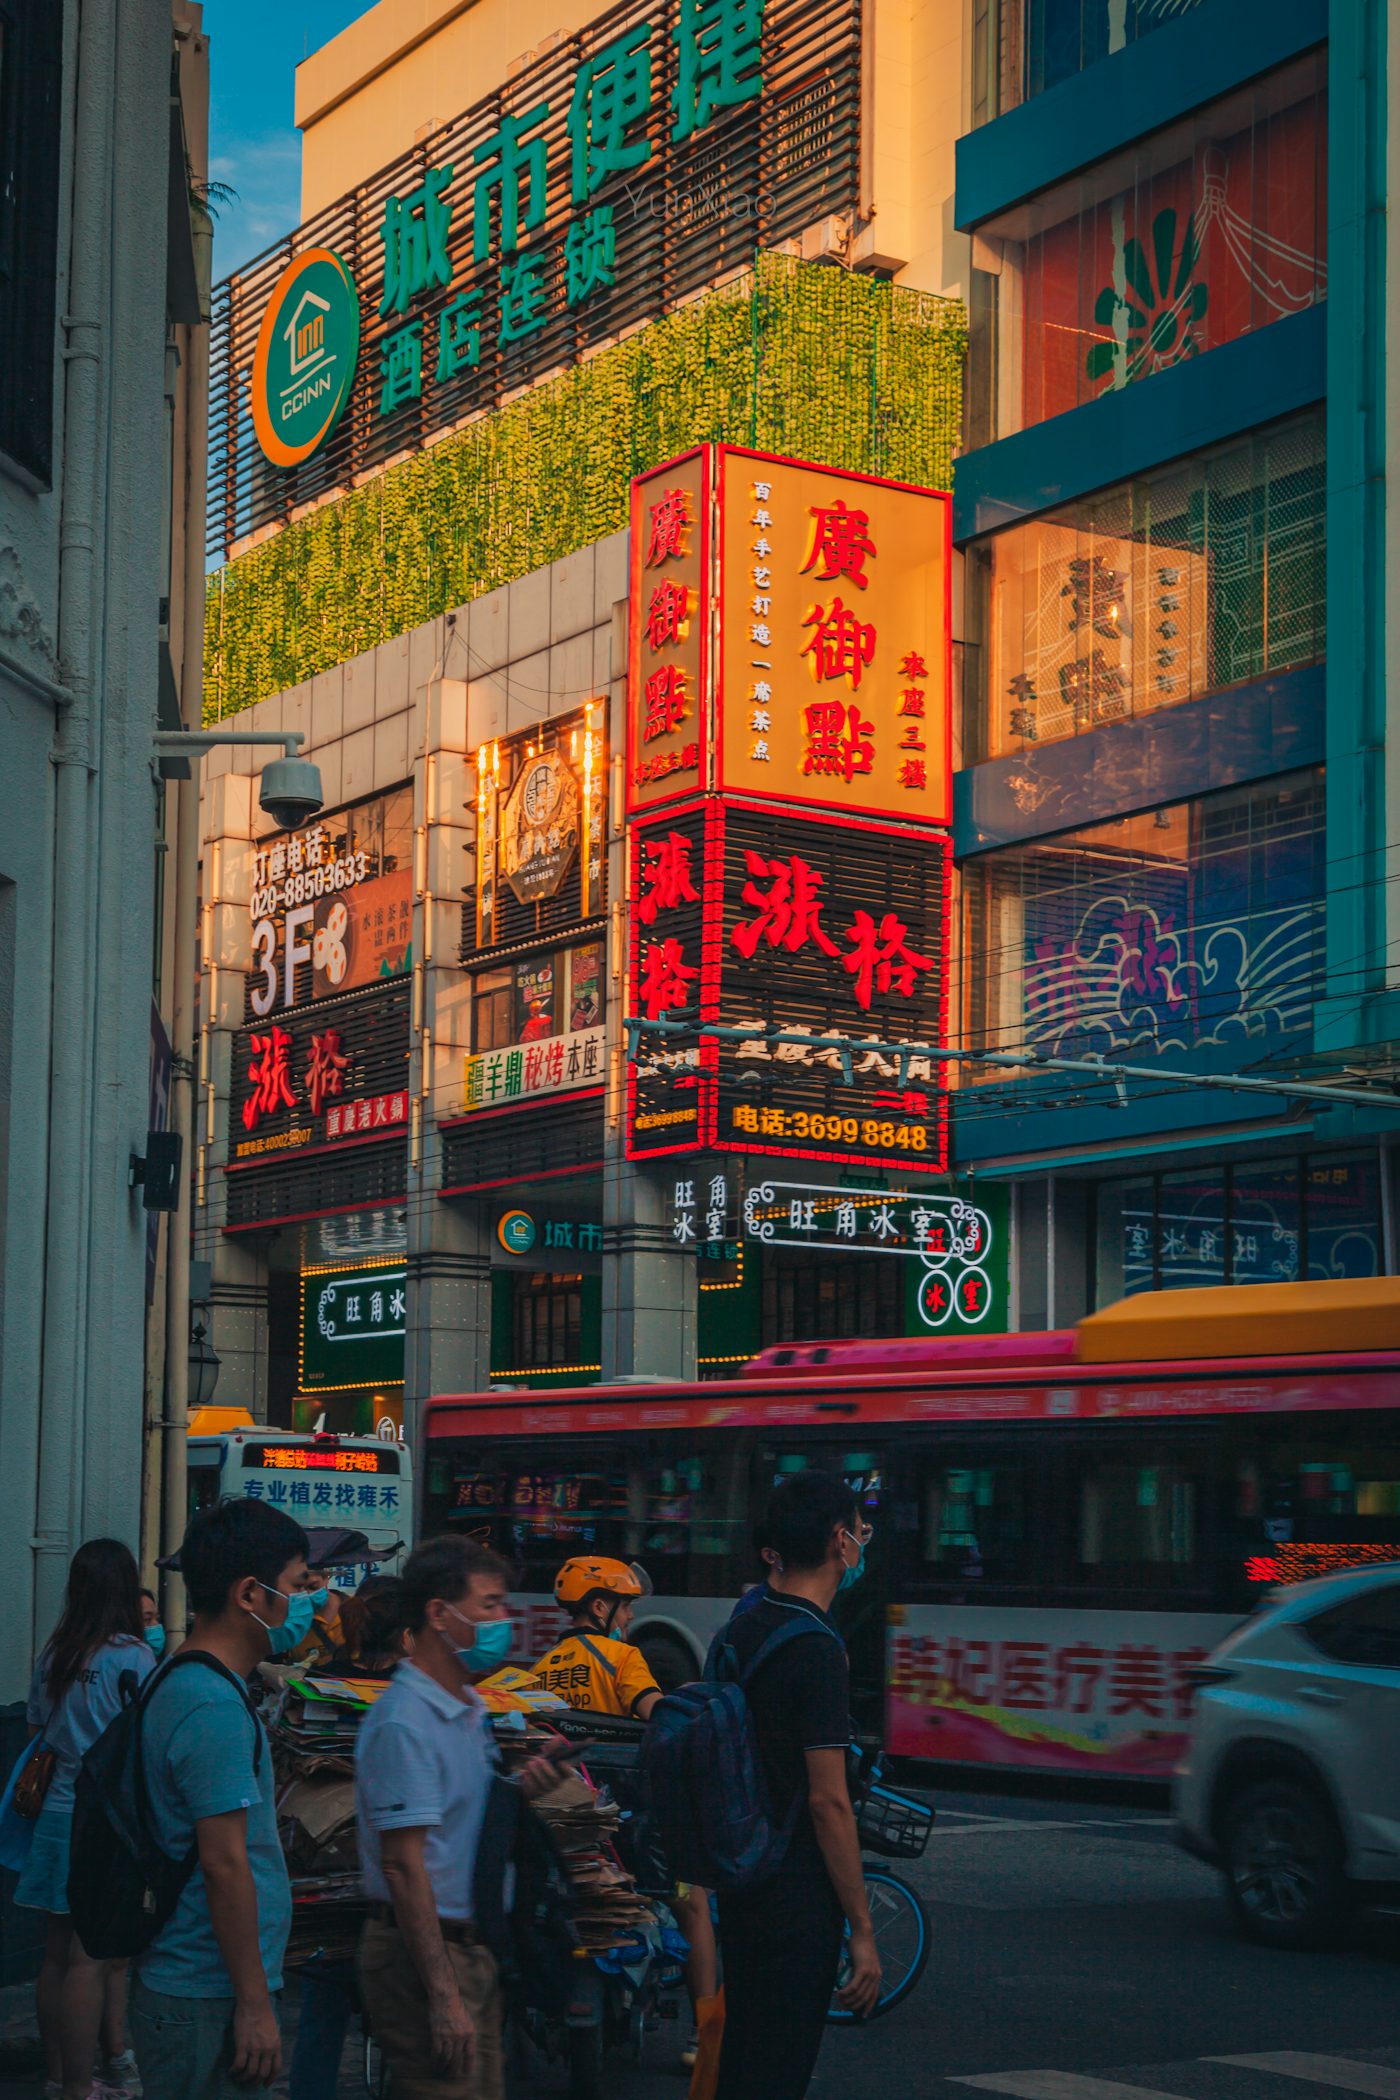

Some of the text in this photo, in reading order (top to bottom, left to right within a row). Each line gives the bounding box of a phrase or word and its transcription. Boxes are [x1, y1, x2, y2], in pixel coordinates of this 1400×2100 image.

[380, 0, 764, 317] 城市便捷
[380, 206, 617, 417] 酒店连锁
[281, 373, 331, 421] CCINN
[751, 481, 773, 762] 百年手艺打造一席茶点
[799, 499, 878, 783] 廣御點
[899, 650, 929, 791] 本座三楼
[252, 826, 324, 887] 订座电话
[249, 851, 365, 921] 020-88503633
[249, 903, 315, 1017] 3F
[674, 1174, 727, 1209] 旺角
[545, 1219, 603, 1252] 城市
[672, 1208, 727, 1244] 冰室
[789, 1199, 935, 1244] 旺角冰室
[346, 1288, 407, 1323] 旺角冰
[925, 1278, 982, 1313] 冰室
[243, 1479, 400, 1509] 专业植发找雍禾
